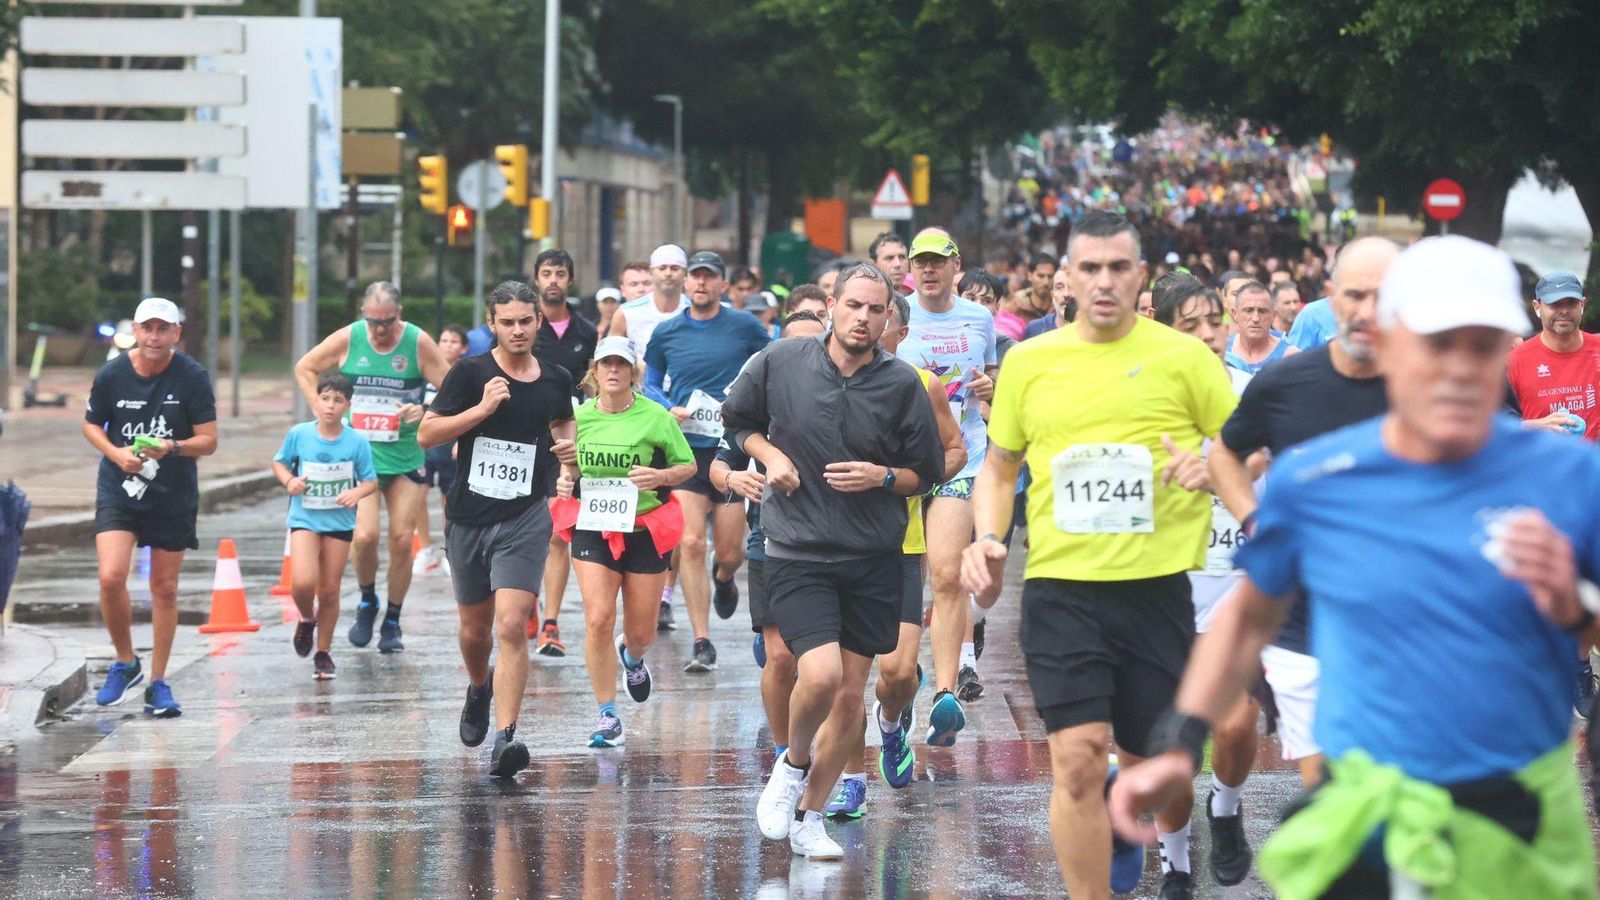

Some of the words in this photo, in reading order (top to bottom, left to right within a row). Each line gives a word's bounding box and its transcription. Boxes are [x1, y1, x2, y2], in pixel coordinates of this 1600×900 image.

[356, 375, 405, 389] ATLETISMO
[1547, 385, 1584, 397] GENERALI
[362, 415, 390, 430] 172
[579, 451, 642, 469] TRANCA
[478, 461, 527, 483] 11381
[305, 481, 349, 497] 21814
[1065, 479, 1145, 502] 11244
[589, 498, 628, 514] 6980
